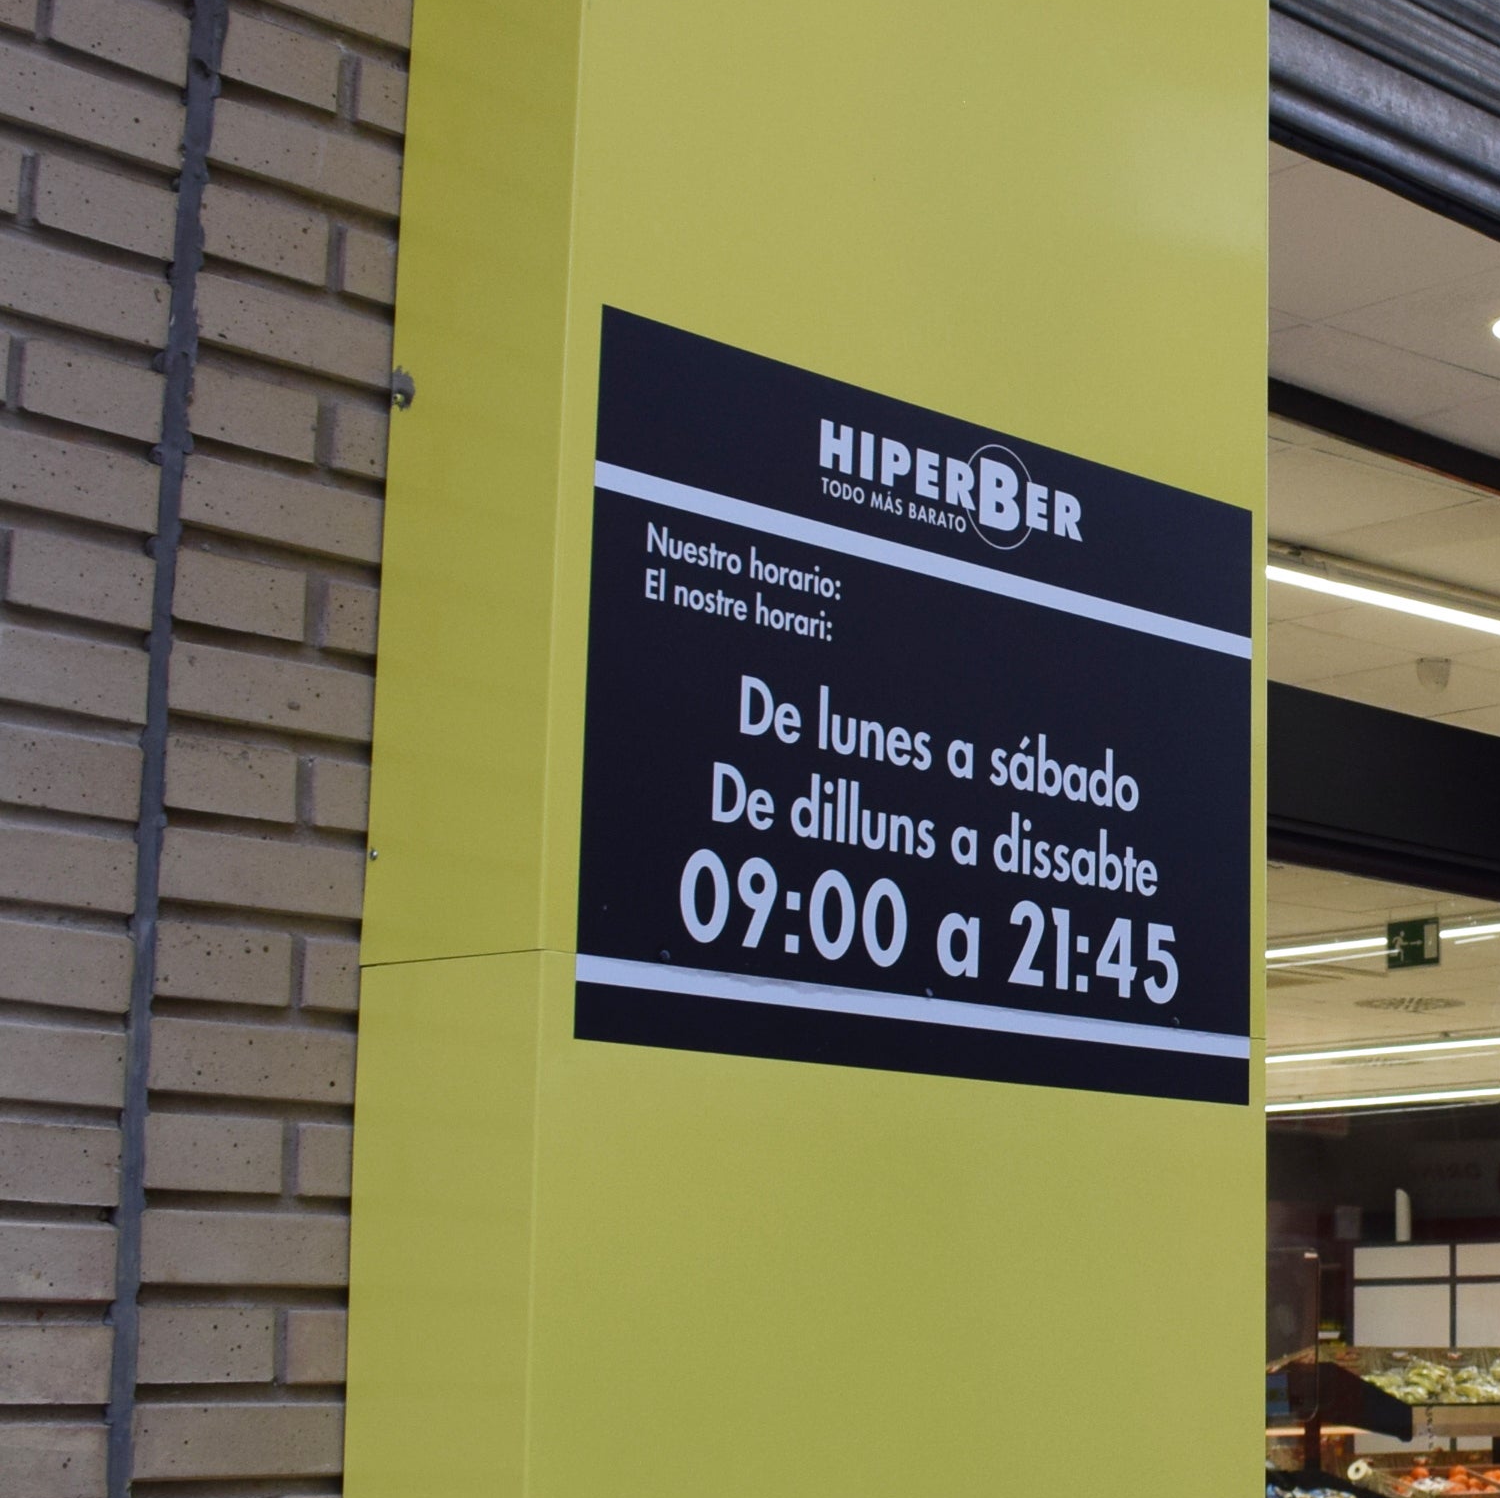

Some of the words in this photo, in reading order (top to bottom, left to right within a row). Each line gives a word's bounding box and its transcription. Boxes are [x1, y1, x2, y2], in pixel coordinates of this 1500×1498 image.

[819, 418, 1083, 542] HIPERBER
[821, 476, 866, 505] TODO
[870, 491, 904, 516] MÁS
[908, 501, 967, 533] BARATO
[645, 567, 666, 602] El
[673, 584, 748, 621] nostre
[755, 591, 833, 642] horari:
[646, 521, 742, 575] Nuestro
[749, 545, 842, 601] horario:
[739, 674, 802, 744] De
[818, 684, 933, 771] lunes
[946, 739, 974, 780] a
[989, 734, 1140, 812] sábado
[711, 761, 775, 831] De
[790, 772, 936, 859] dilluns
[950, 826, 978, 867] a
[992, 811, 1158, 897] dissabte
[679, 848, 908, 968] 09:00
[936, 912, 980, 979] a
[1007, 899, 1179, 1005] 21:45
